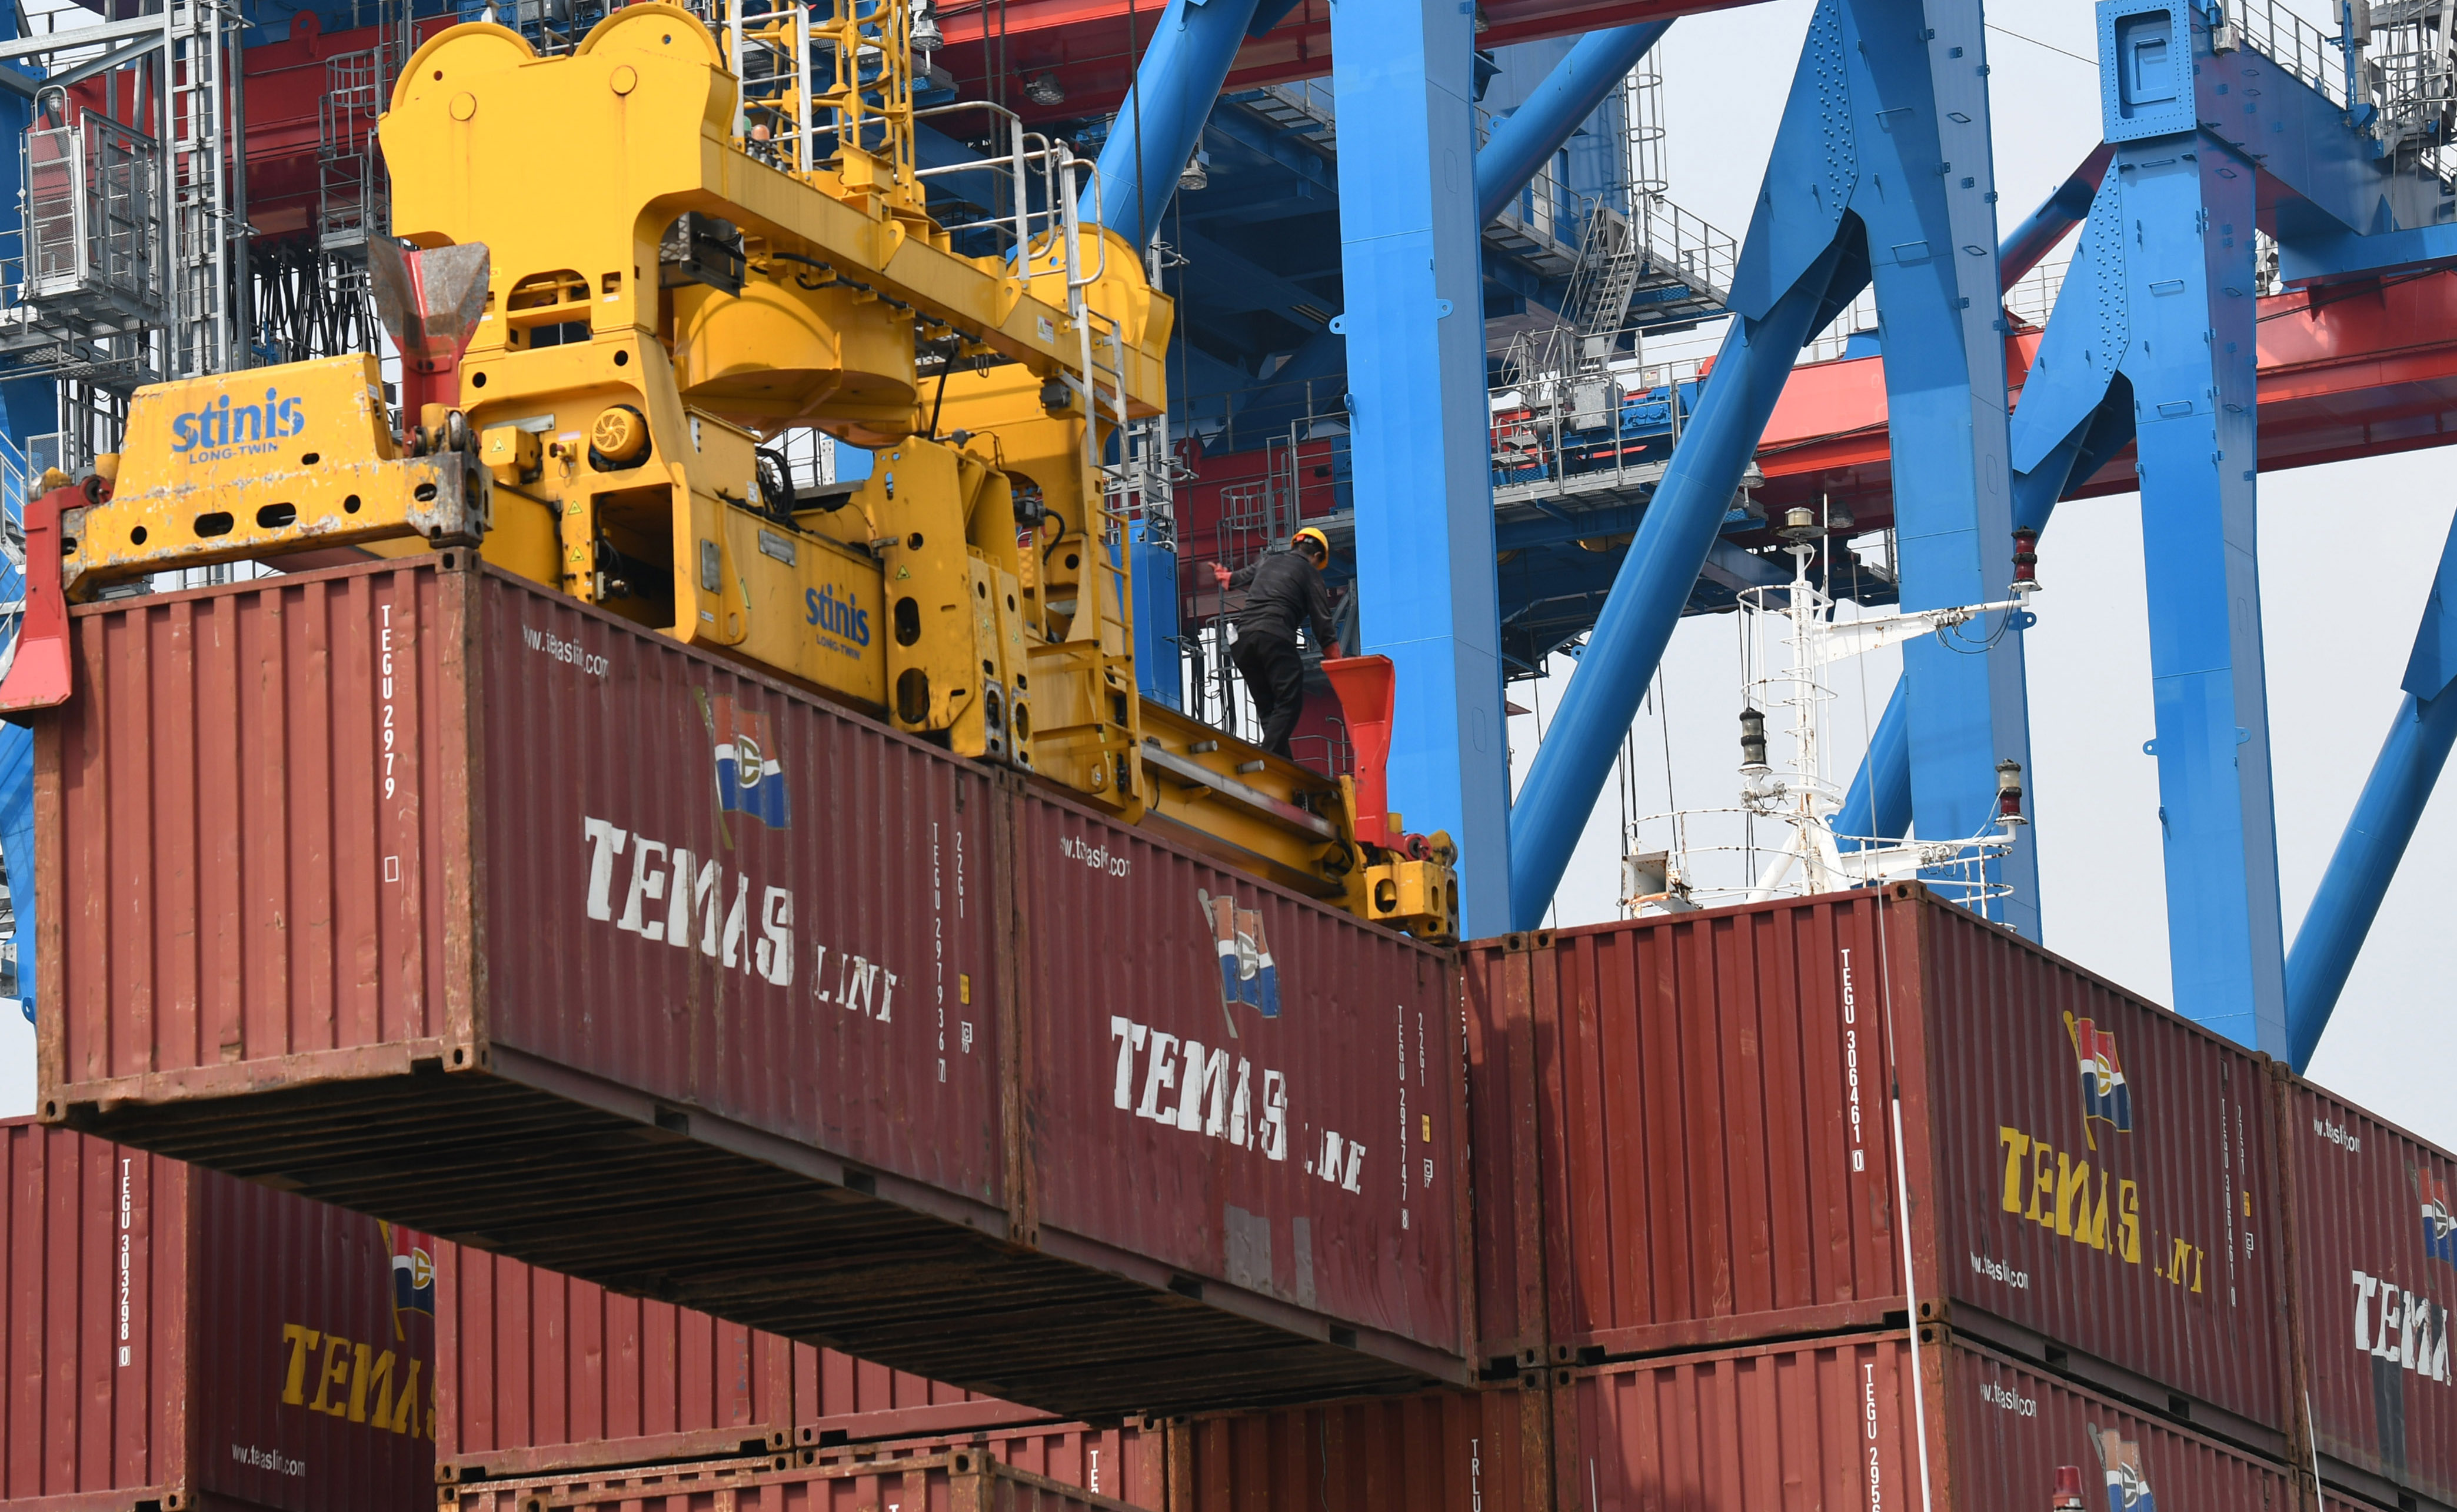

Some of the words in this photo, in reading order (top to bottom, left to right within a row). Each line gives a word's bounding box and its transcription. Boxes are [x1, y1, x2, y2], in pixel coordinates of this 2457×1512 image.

[172, 387, 305, 452] stinis
[189, 442, 278, 464] LONG-TWIN
[381, 605, 392, 700] TEGU
[805, 583, 870, 647] stinis
[816, 634, 860, 660] LONG-TWIN
[384, 705, 395, 800] 2979
[584, 816, 794, 987] TEMAS
[935, 918, 944, 1051] 297936
[1841, 948, 1855, 1024] TEGU
[1111, 1015, 1288, 1161] TEMAS
[1304, 1122, 1366, 1195] INE
[1847, 1030, 1860, 1143] 306461
[121, 1158, 131, 1229] TEGU
[1853, 1151, 1863, 1171] 0
[2000, 1125, 2142, 1264] TEMAS
[2225, 1174, 2234, 1280] 306461
[121, 1234, 129, 1340] 303298
[120, 1347, 129, 1366] 0
[1864, 1364, 1877, 1439] TEGU
[1471, 1438, 1481, 1512] TRLU
